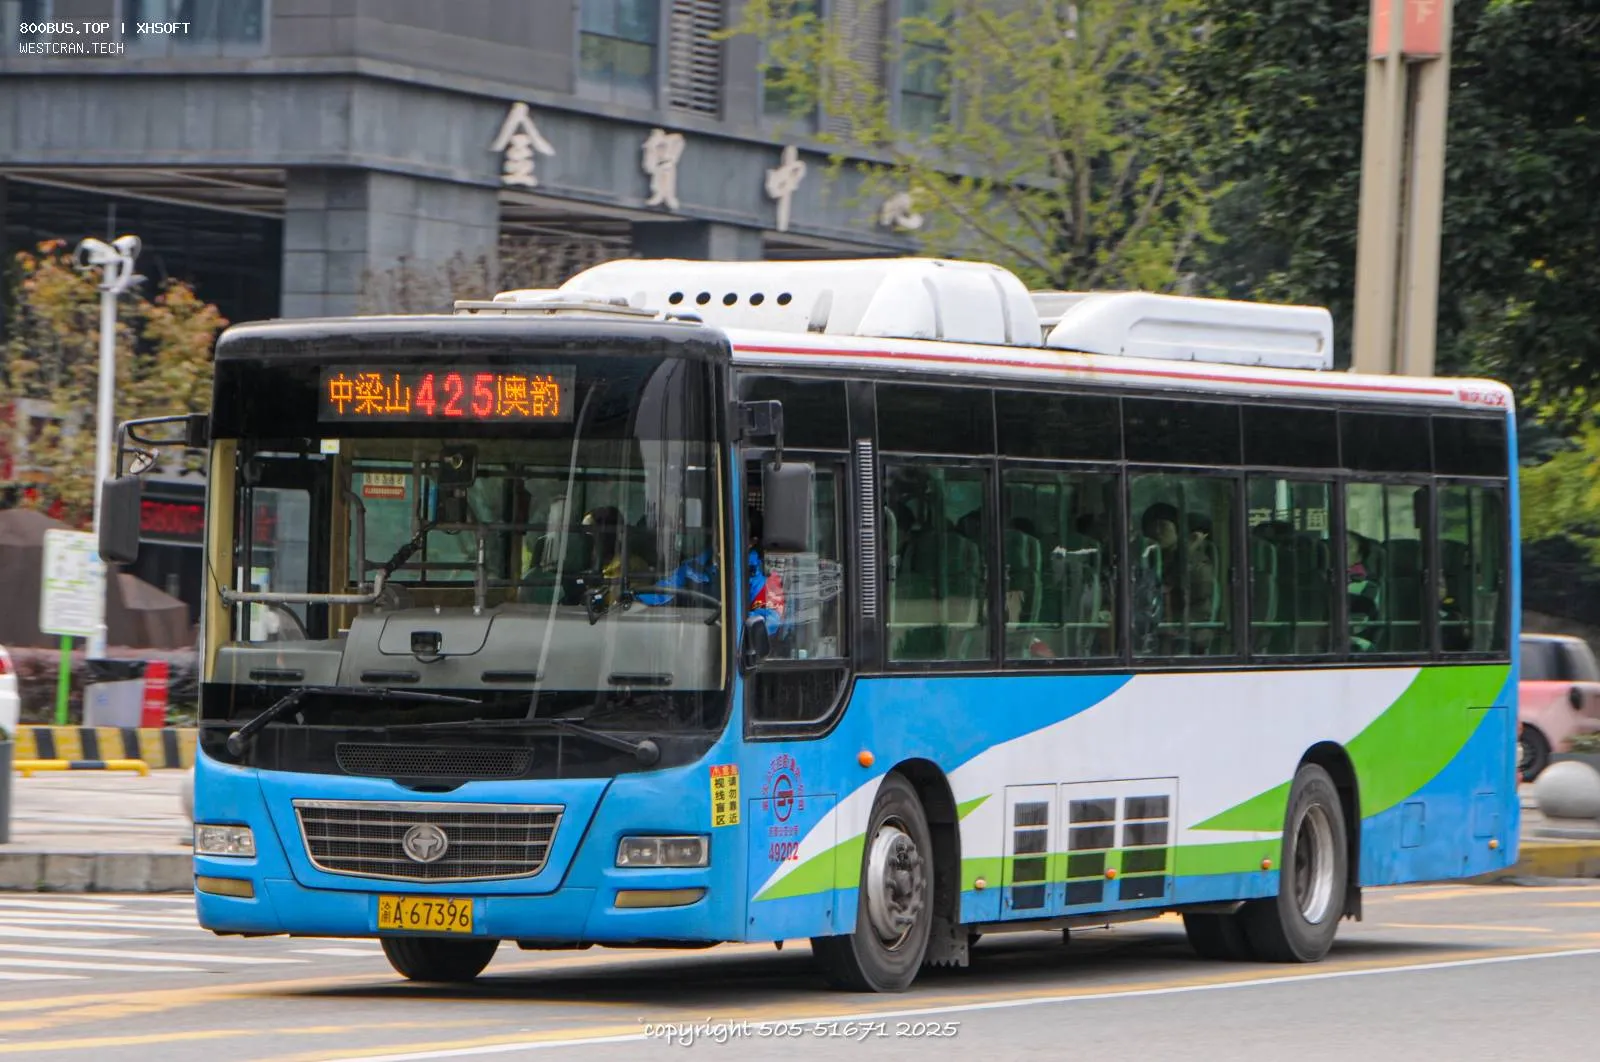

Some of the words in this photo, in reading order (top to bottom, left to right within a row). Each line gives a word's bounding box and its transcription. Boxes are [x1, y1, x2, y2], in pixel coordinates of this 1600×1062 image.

[329, 373, 411, 415] 中梁山
[415, 373, 493, 416] 425
[714, 777, 726, 826] 视线盲区
[768, 842, 799, 862] 49202
